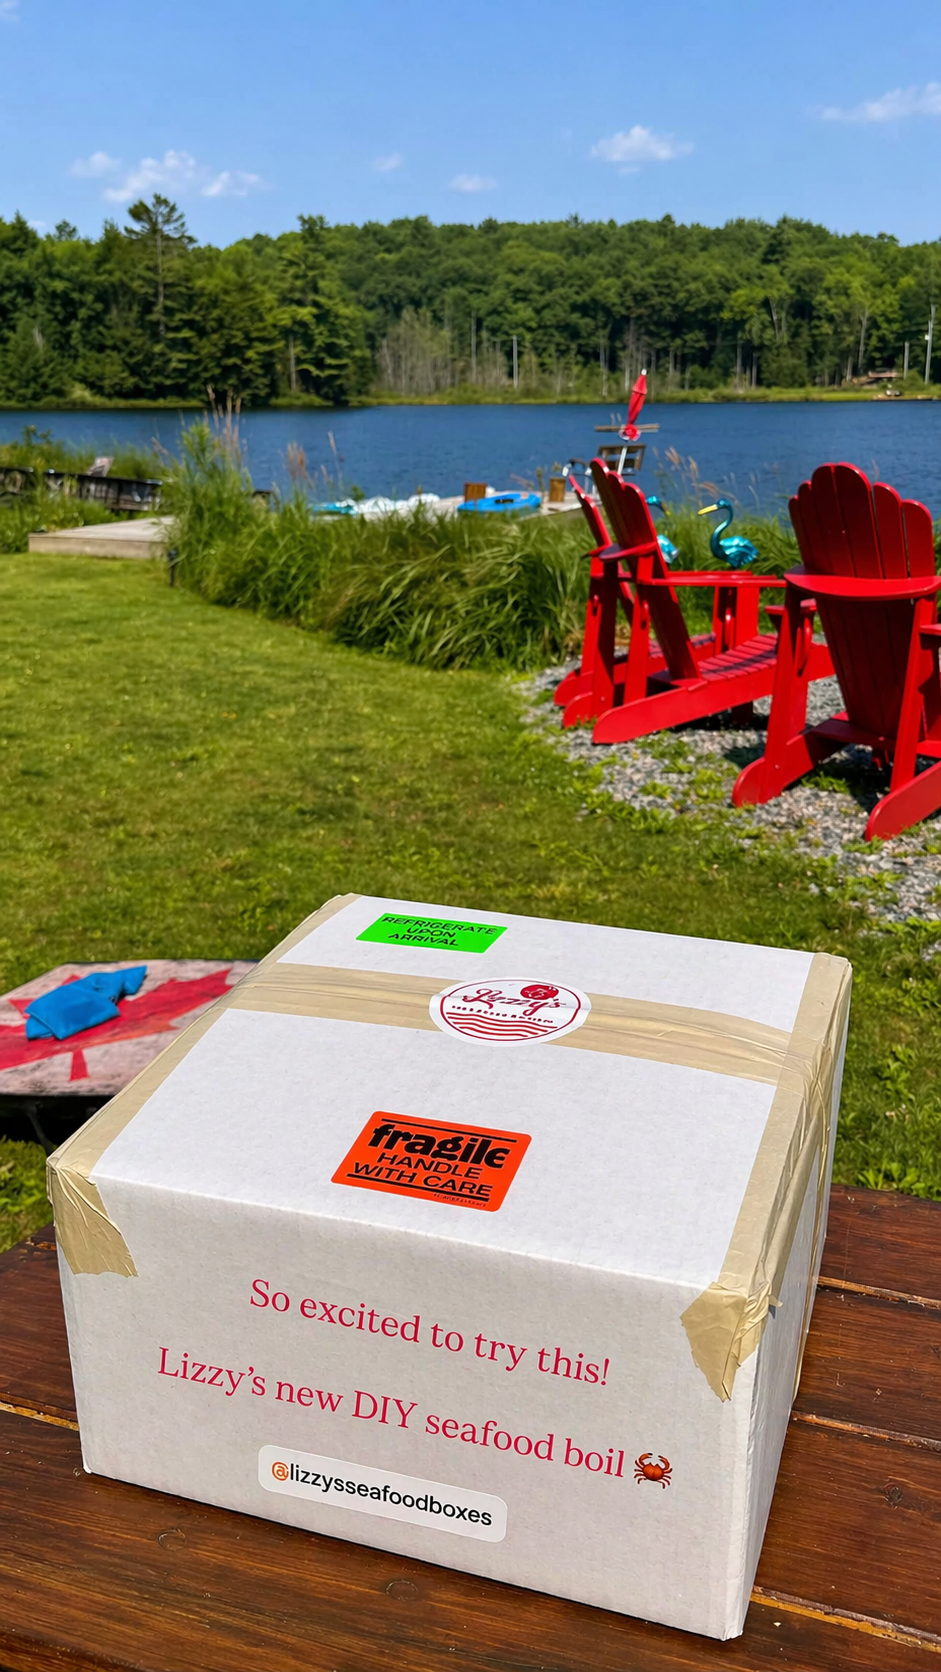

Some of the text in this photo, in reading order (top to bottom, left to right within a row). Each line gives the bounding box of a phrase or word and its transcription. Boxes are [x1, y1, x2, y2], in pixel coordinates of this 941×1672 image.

[381, 916, 498, 935] REFRIGERATE
[406, 927, 457, 938] UPON
[387, 933, 459, 946] ARRIVAL
[368, 1124, 511, 1169] fragile
[376, 1152, 483, 1180] HANDLE
[354, 1162, 494, 1197] WITH CARE
